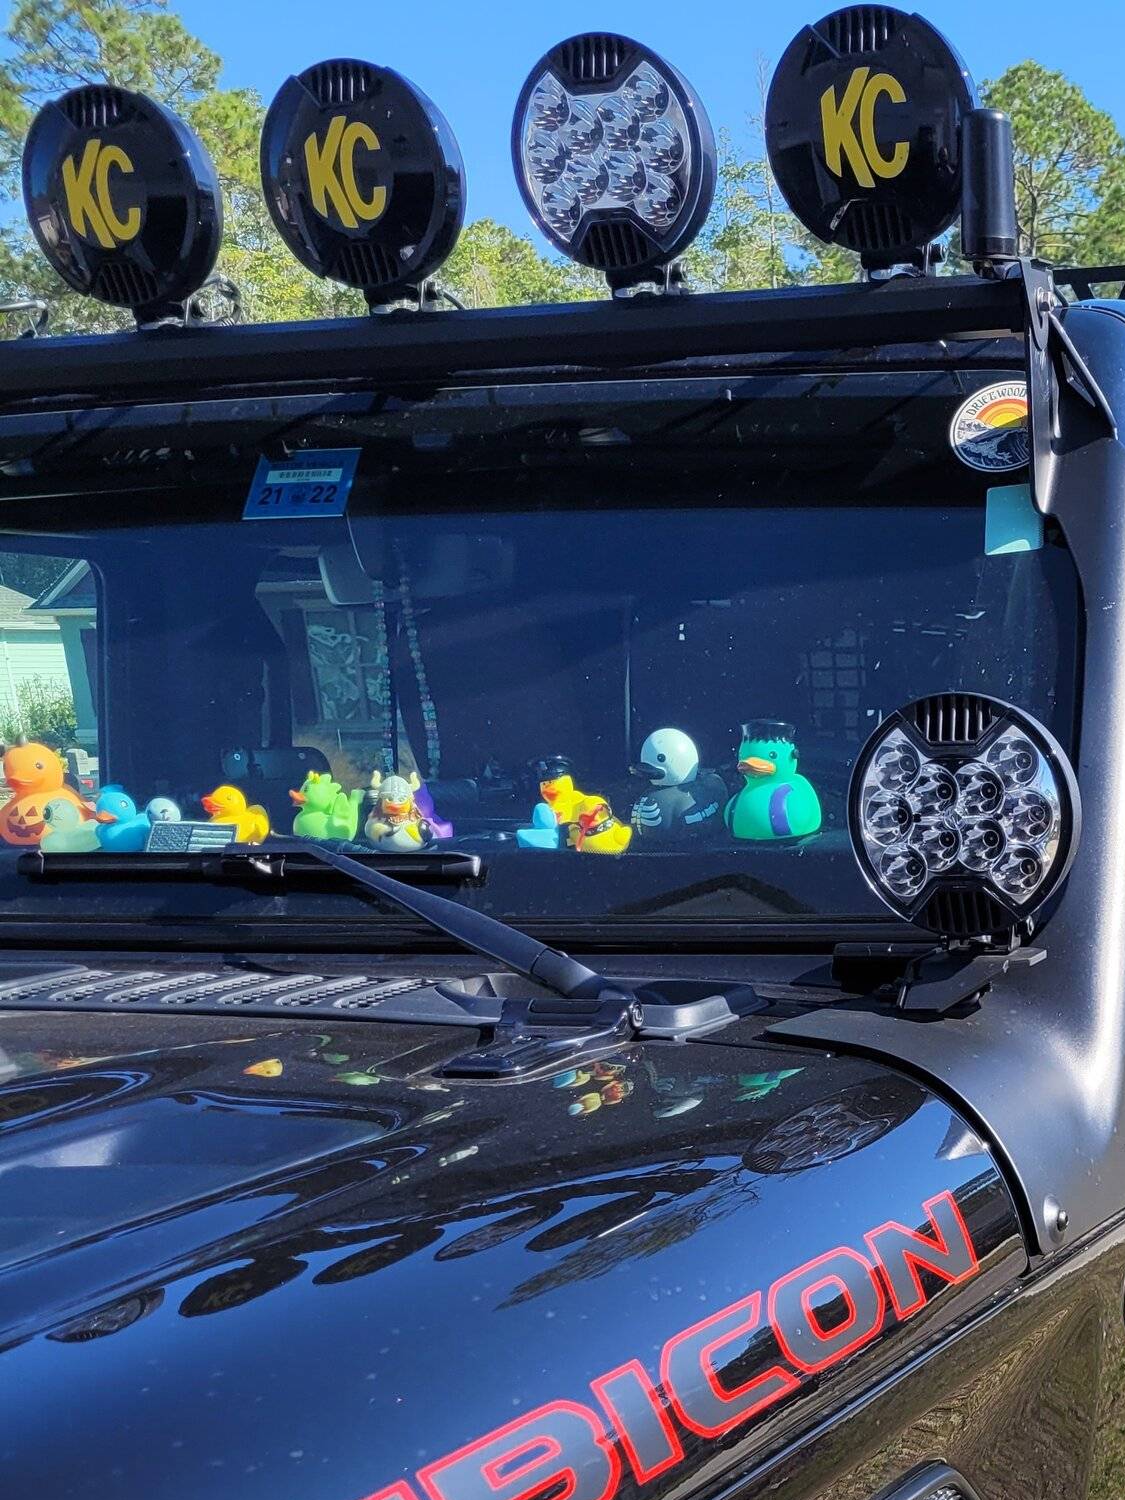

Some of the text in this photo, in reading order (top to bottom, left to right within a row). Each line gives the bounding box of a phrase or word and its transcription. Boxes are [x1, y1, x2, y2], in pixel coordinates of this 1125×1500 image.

[304, 115, 387, 228] KC
[821, 67, 910, 187] KC
[62, 138, 141, 248] KC
[257, 485, 338, 505] 21 22
